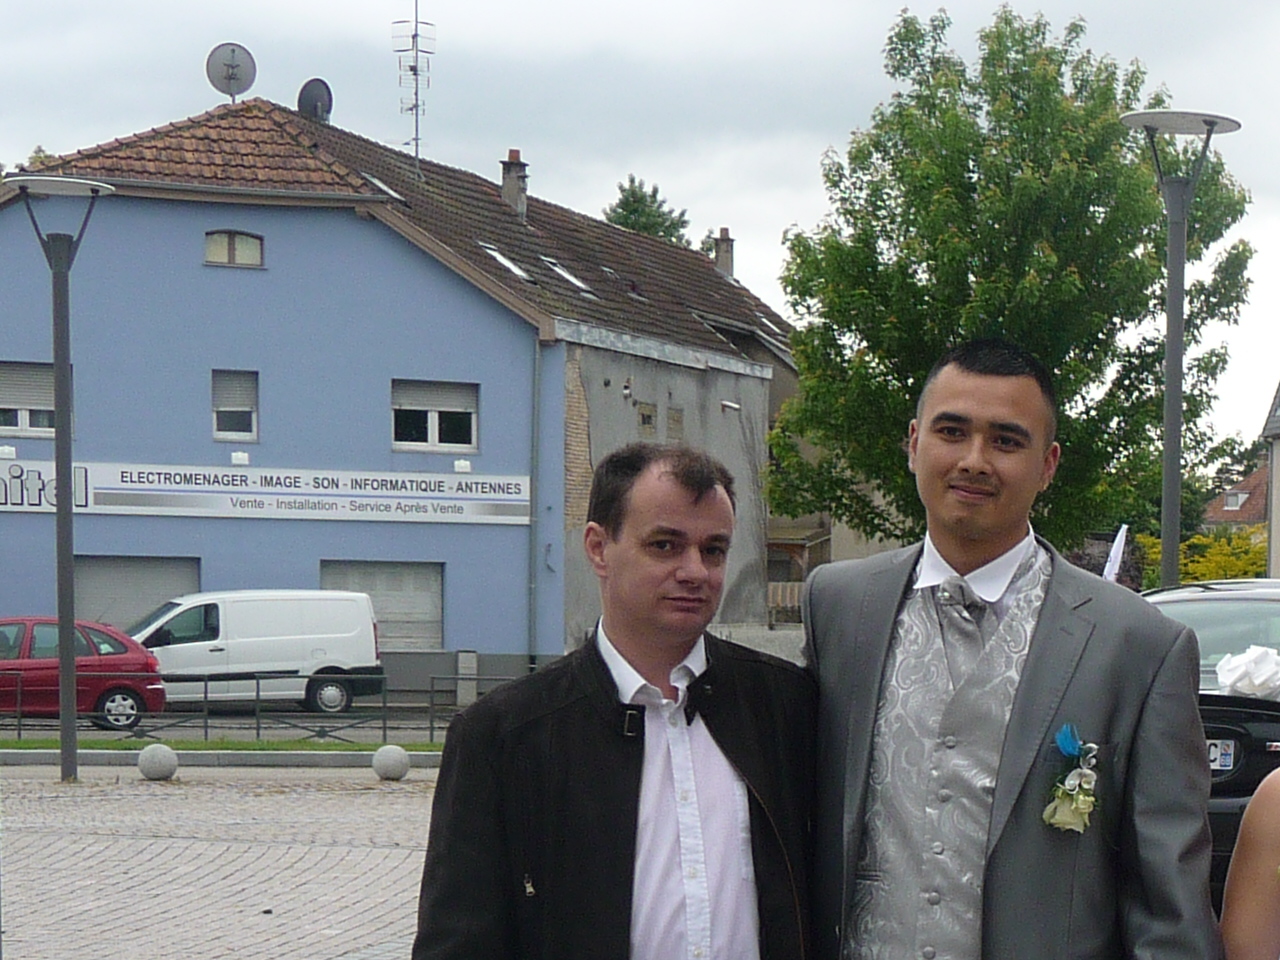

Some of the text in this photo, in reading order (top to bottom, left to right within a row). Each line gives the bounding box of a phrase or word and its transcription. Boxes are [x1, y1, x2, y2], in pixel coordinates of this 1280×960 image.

[0, 464, 88, 507] itl
[120, 470, 249, 487] ELECTROMENAGER
[260, 475, 301, 488] IMAGE
[312, 476, 340, 490] SON
[350, 478, 445, 493] INFORMATIQUE
[455, 481, 522, 495] ANTENNES
[230, 497, 265, 509] Vente
[276, 498, 338, 511] Installation
[349, 500, 391, 513] Service
[395, 501, 428, 515] Après
[431, 502, 464, 515] Vente
[1208, 742, 1218, 763] C
